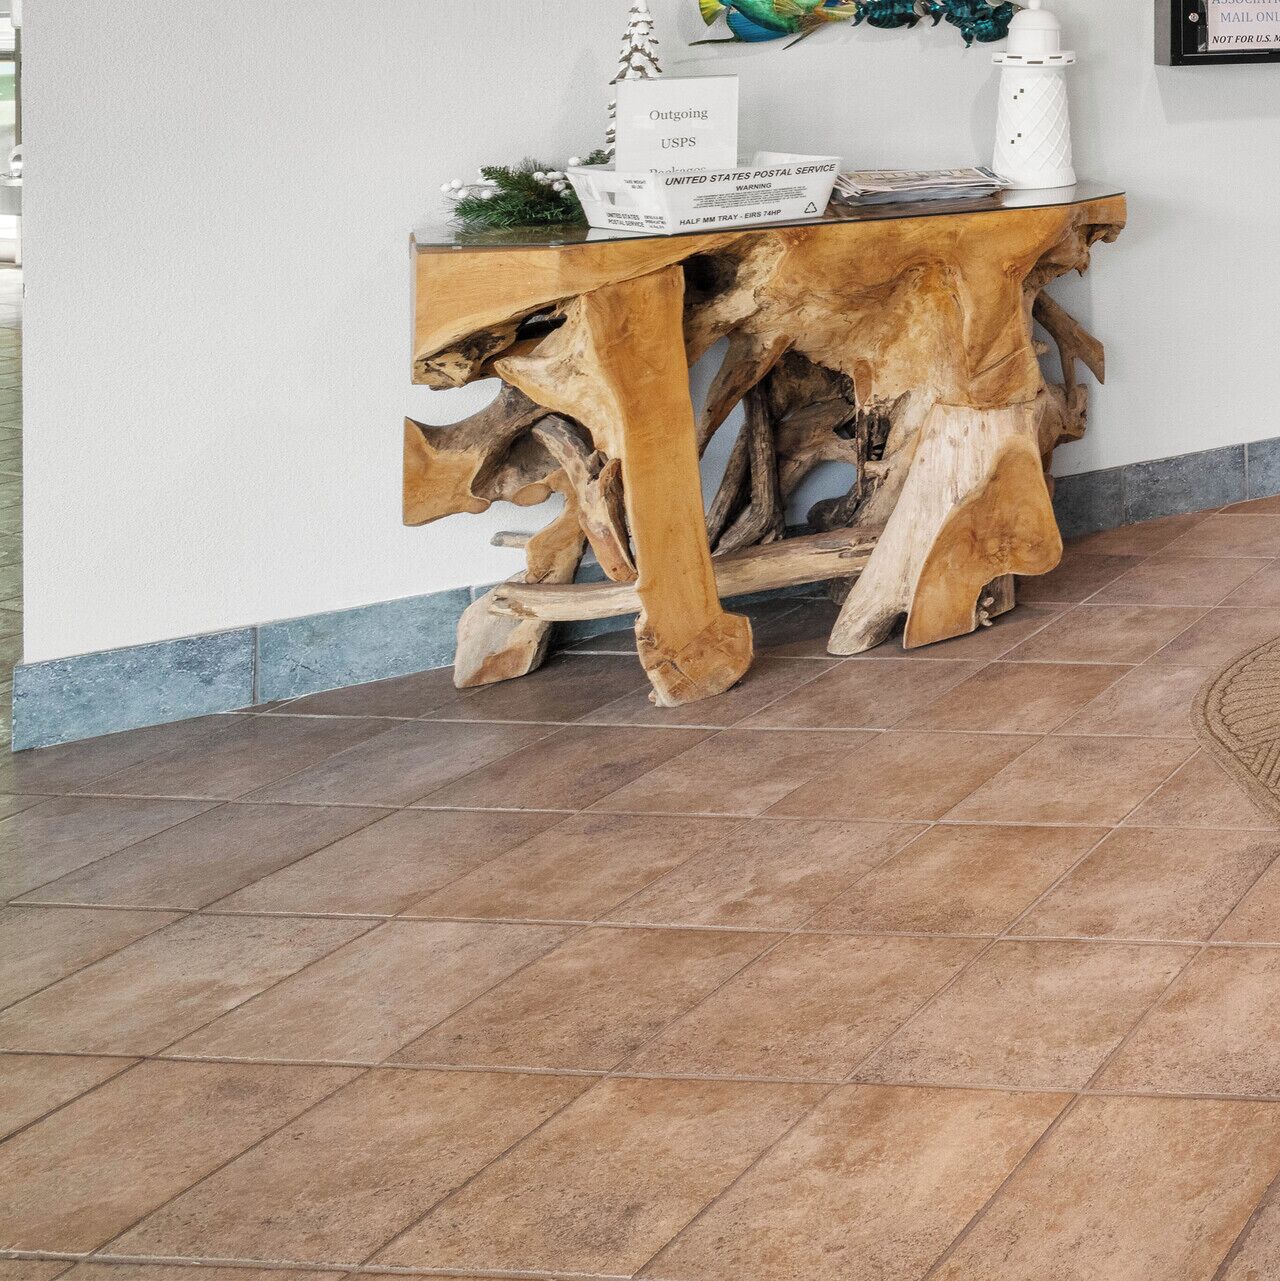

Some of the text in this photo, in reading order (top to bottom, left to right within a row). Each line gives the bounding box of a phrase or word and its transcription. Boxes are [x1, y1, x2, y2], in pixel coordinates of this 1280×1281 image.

[1220, 11, 1253, 23] MAIL
[1212, 35, 1233, 43] NOT
[1235, 35, 1254, 43] FOR
[1256, 35, 1271, 43] U.S.
[649, 108, 709, 122] Outgoing
[661, 137, 696, 149] USPS
[665, 163, 836, 186] UNITED STATES POSTAL SERVICE
[735, 183, 772, 191] WARNING
[679, 217, 701, 226] HALF
[718, 214, 738, 222] TRAY
[744, 211, 762, 219] EIRS
[763, 209, 782, 217] 74HP
